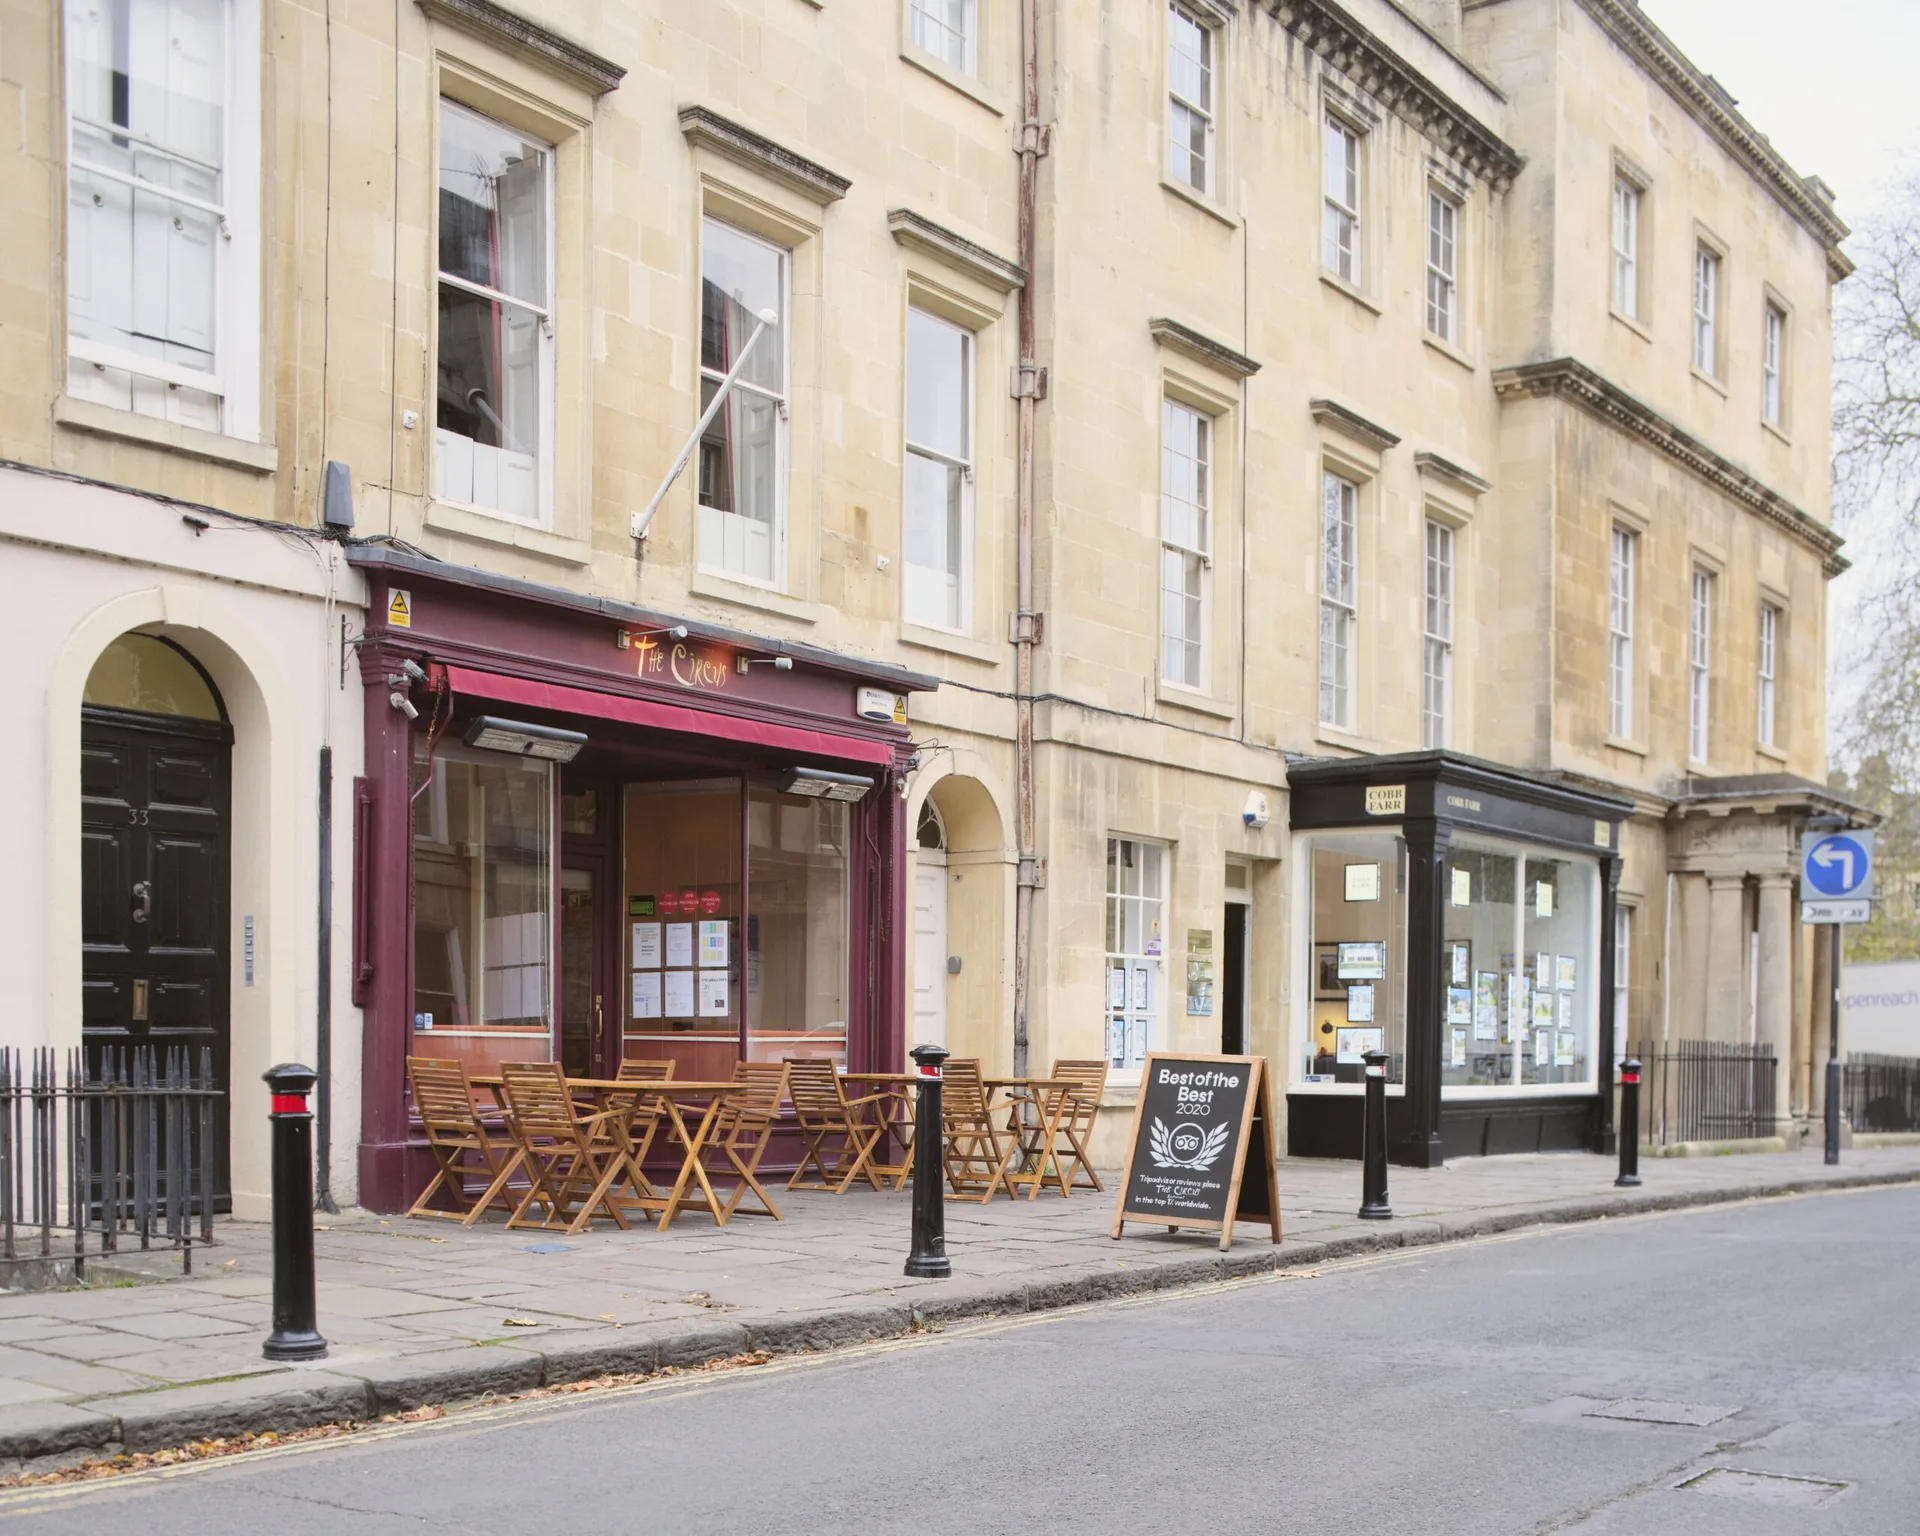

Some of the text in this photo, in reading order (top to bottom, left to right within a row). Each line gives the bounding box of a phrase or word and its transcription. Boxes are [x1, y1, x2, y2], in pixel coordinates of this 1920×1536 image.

[1369, 789, 1402, 800] COBB
[1369, 800, 1402, 811] FARR
[128, 808, 149, 826] 33
[1843, 989, 1919, 1012] penreach
[1158, 1068, 1239, 1088] Best of the
[1177, 1086, 1214, 1103] Best
[1175, 1102, 1211, 1116] 2020
[1140, 1174, 1221, 1189] Tripadvisor reviews place
[1135, 1195, 1141, 1203] in
[1142, 1196, 1153, 1204] the
[1154, 1197, 1166, 1207] top
[1174, 1200, 1212, 1209] worldwide.
